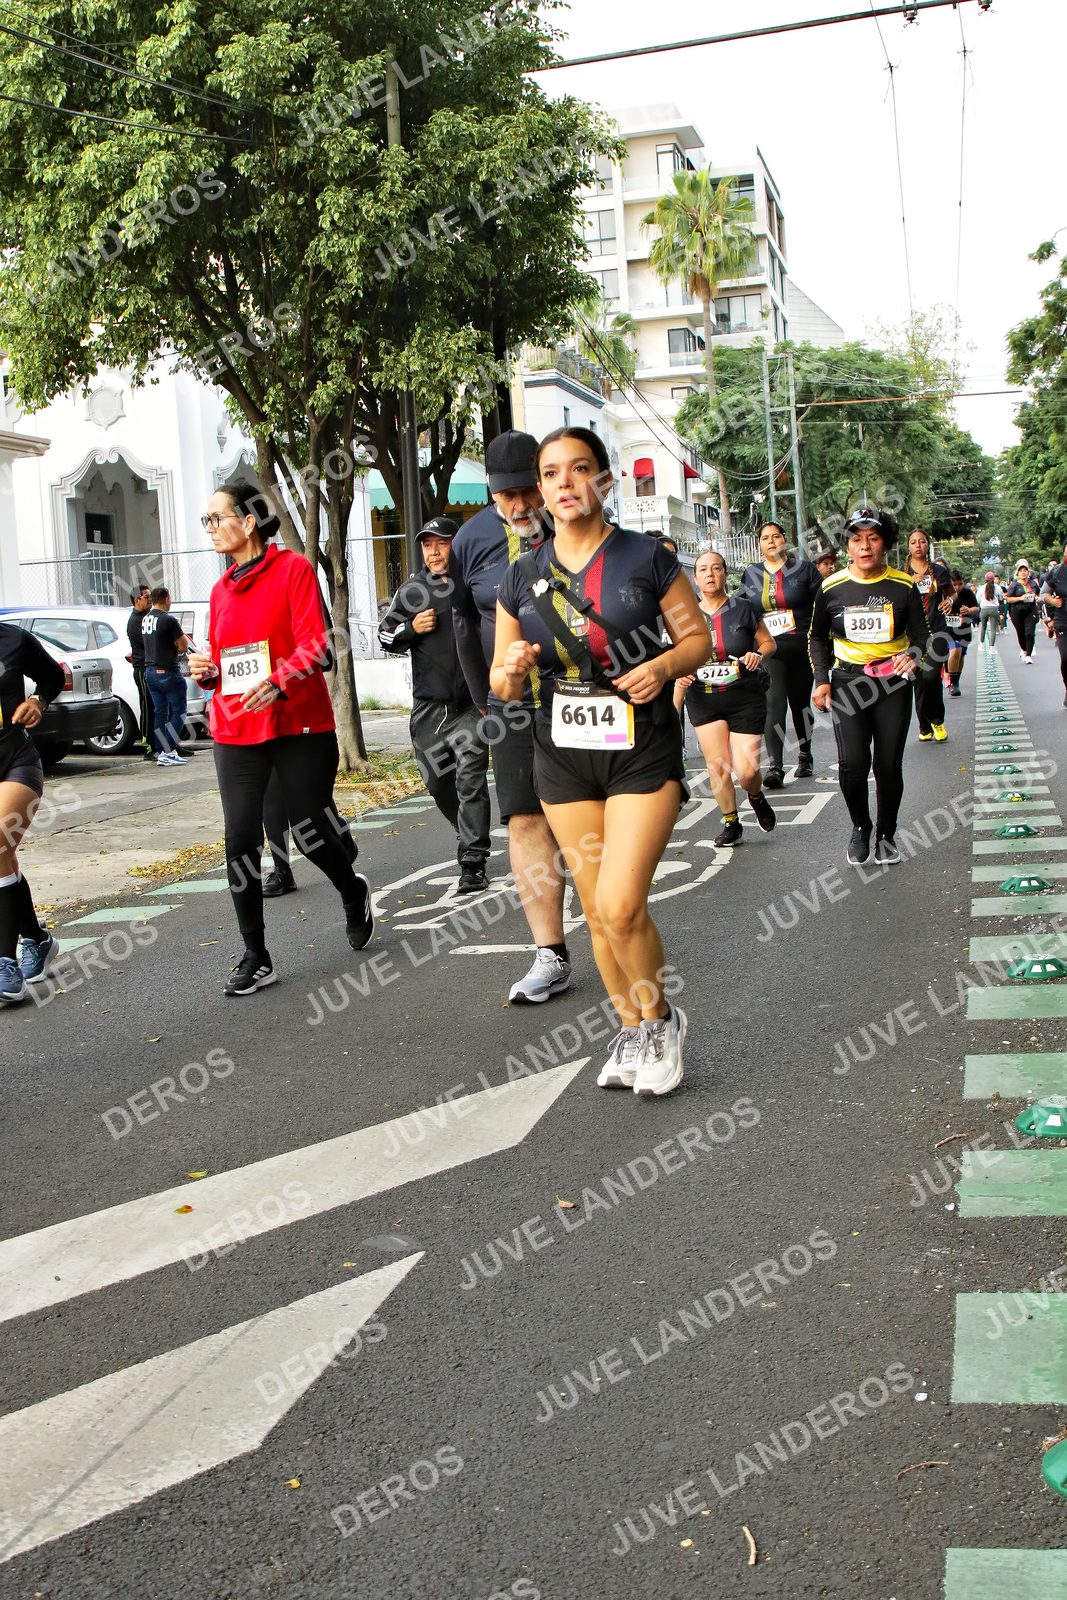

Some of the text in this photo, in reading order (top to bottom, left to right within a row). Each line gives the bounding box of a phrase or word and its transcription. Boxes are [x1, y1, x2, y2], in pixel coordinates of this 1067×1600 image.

[851, 617, 882, 631] 3891
[228, 659, 259, 678] 4833
[703, 667, 730, 679] 5723
[561, 704, 615, 726] 6614
